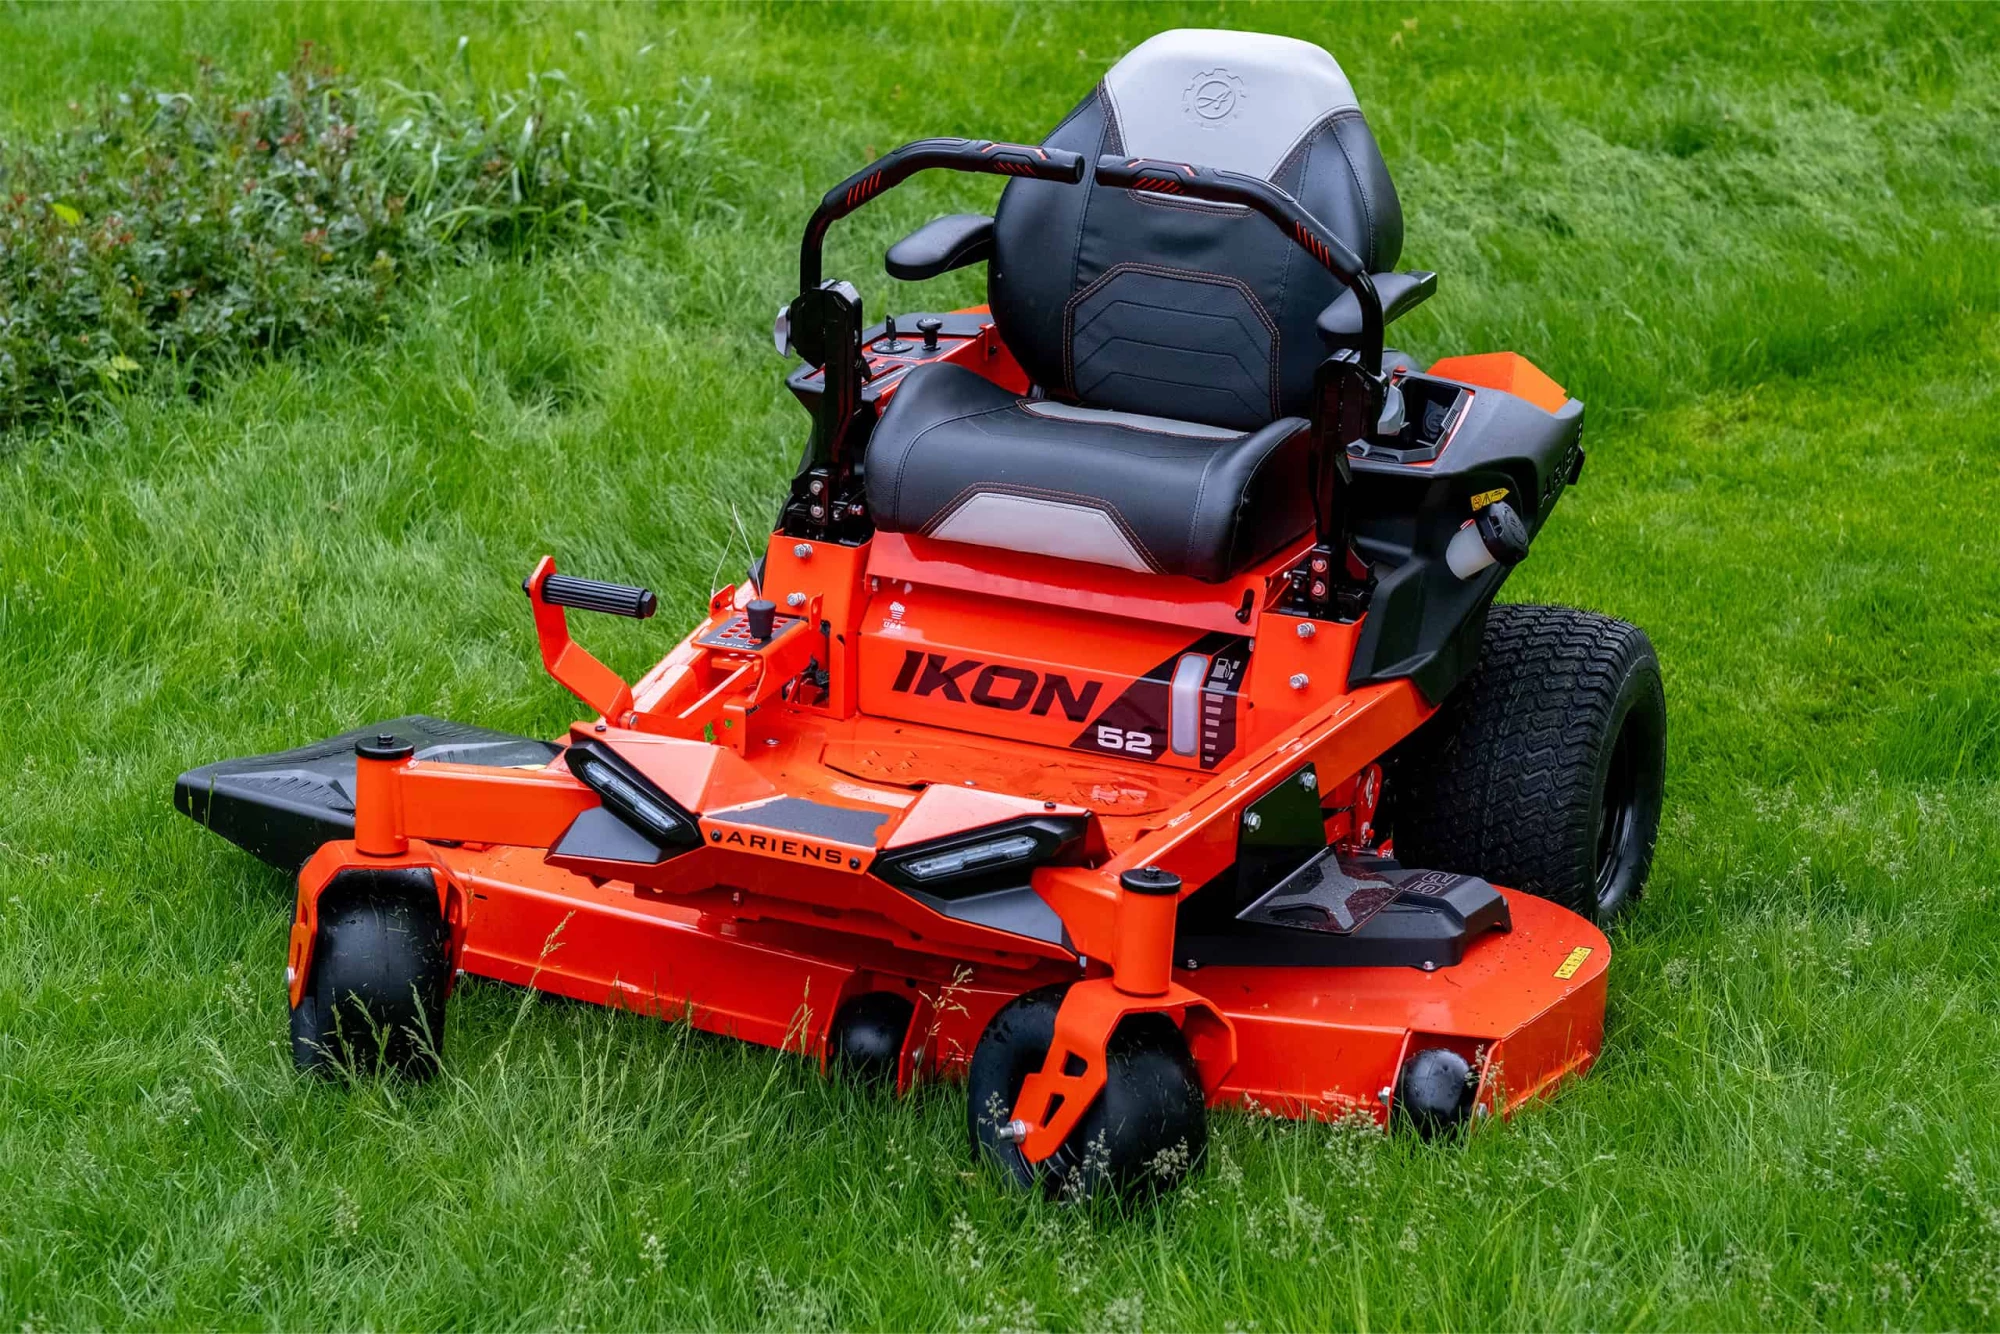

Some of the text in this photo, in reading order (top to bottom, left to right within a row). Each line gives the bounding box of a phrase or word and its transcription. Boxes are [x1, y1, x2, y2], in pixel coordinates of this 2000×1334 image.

[891, 649, 1104, 723] IKON
[1097, 724, 1152, 755] 52
[726, 831, 843, 865] ARIENS
[1404, 871, 1461, 896] 52
